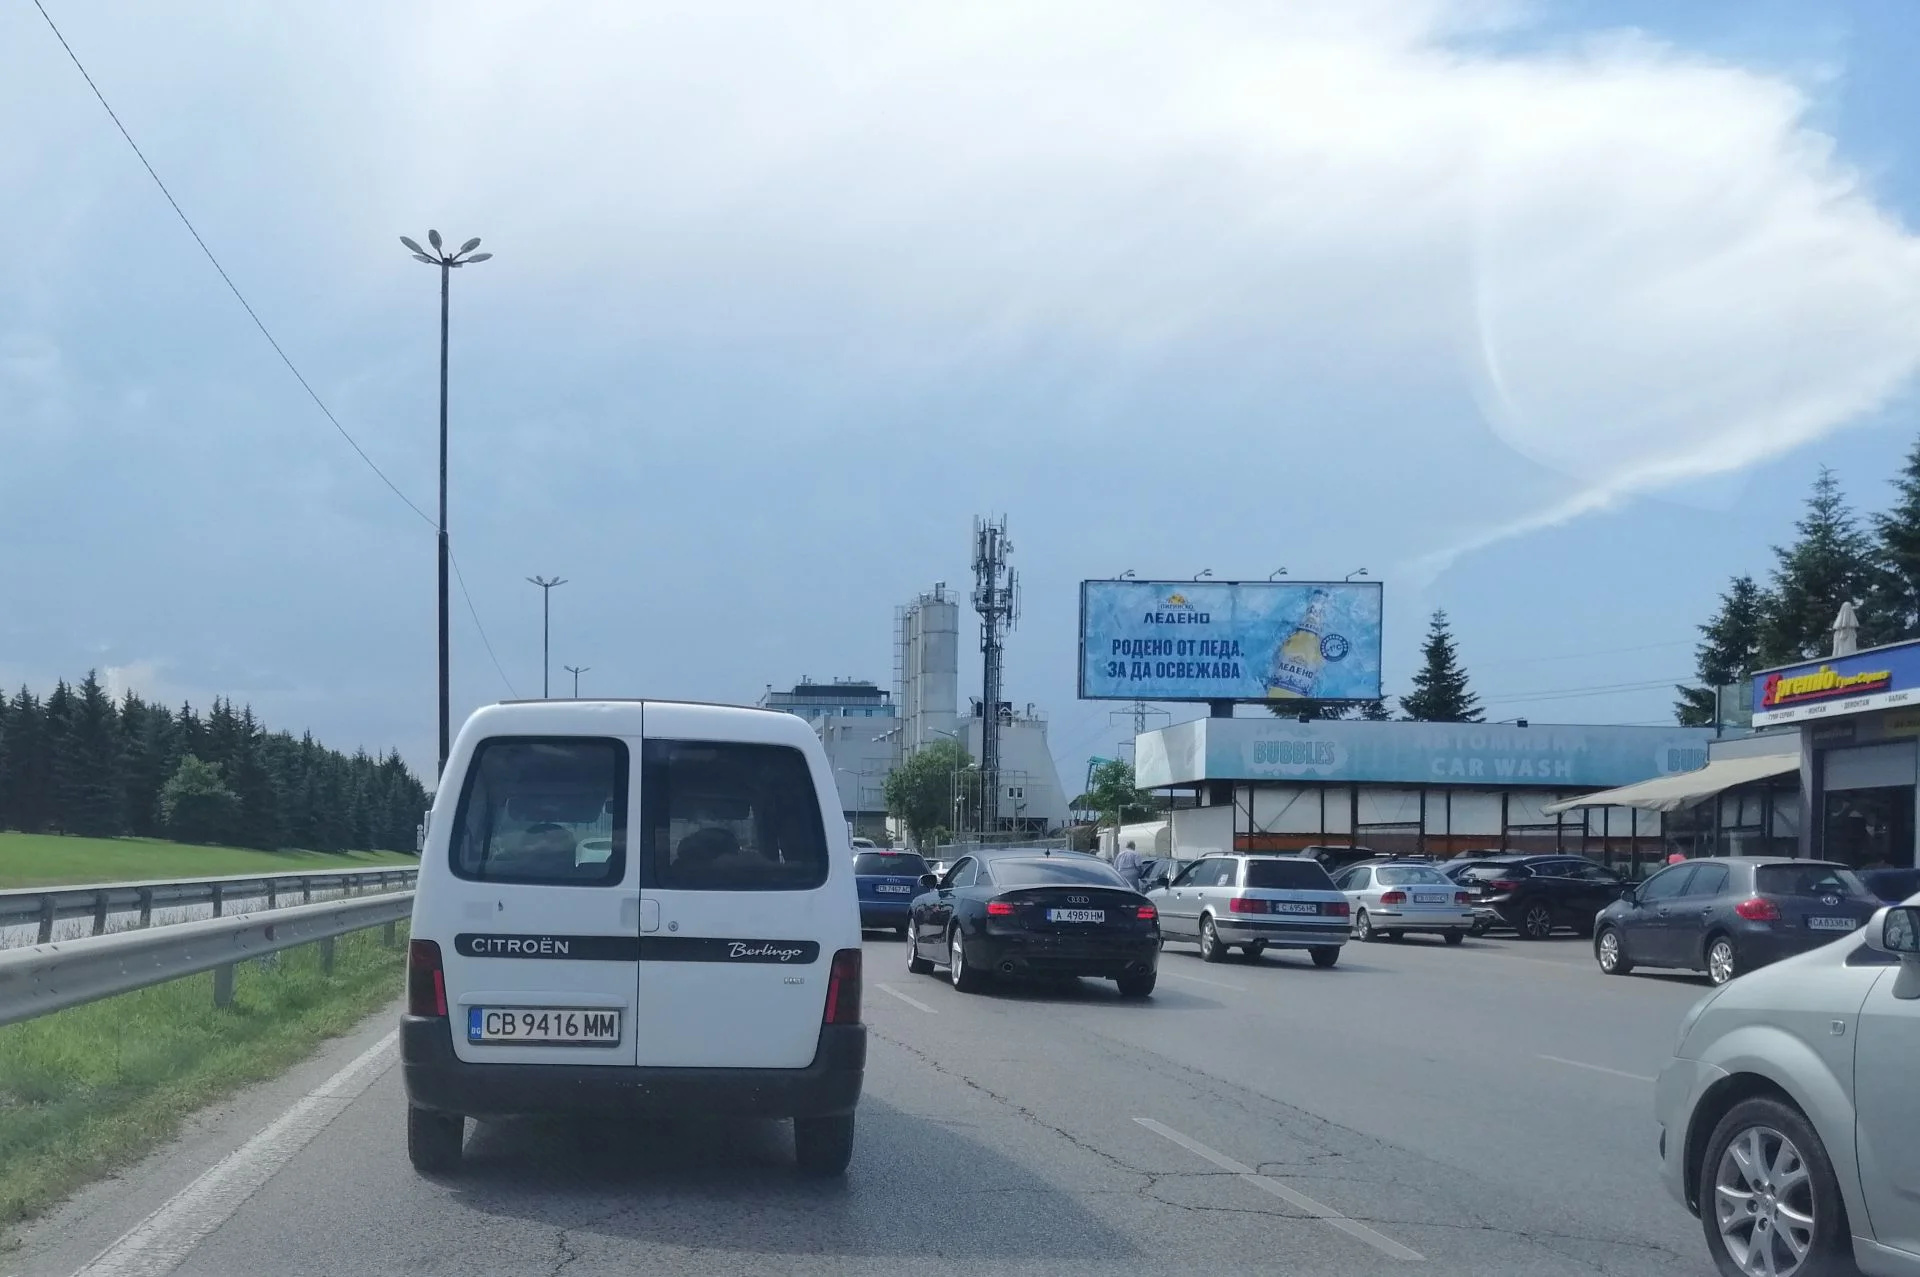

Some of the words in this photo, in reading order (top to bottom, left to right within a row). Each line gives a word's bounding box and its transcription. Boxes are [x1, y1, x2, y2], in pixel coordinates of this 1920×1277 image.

[1143, 612, 1210, 624] ЛЕДЕНО
[1112, 639, 1171, 658] РОДЕНО
[1177, 639, 1194, 657] ОТ
[1199, 640, 1245, 659] ЛЕДА.
[1107, 661, 1127, 678] ЗА
[1130, 661, 1151, 681] ДА
[1155, 661, 1241, 679] ОСВЕЖАВА
[1253, 740, 1336, 766] BUBBLES
[1431, 757, 1485, 777] CAR
[1494, 758, 1571, 778] WASH
[471, 937, 569, 954] CITROËN
[728, 942, 803, 961] Berlingo
